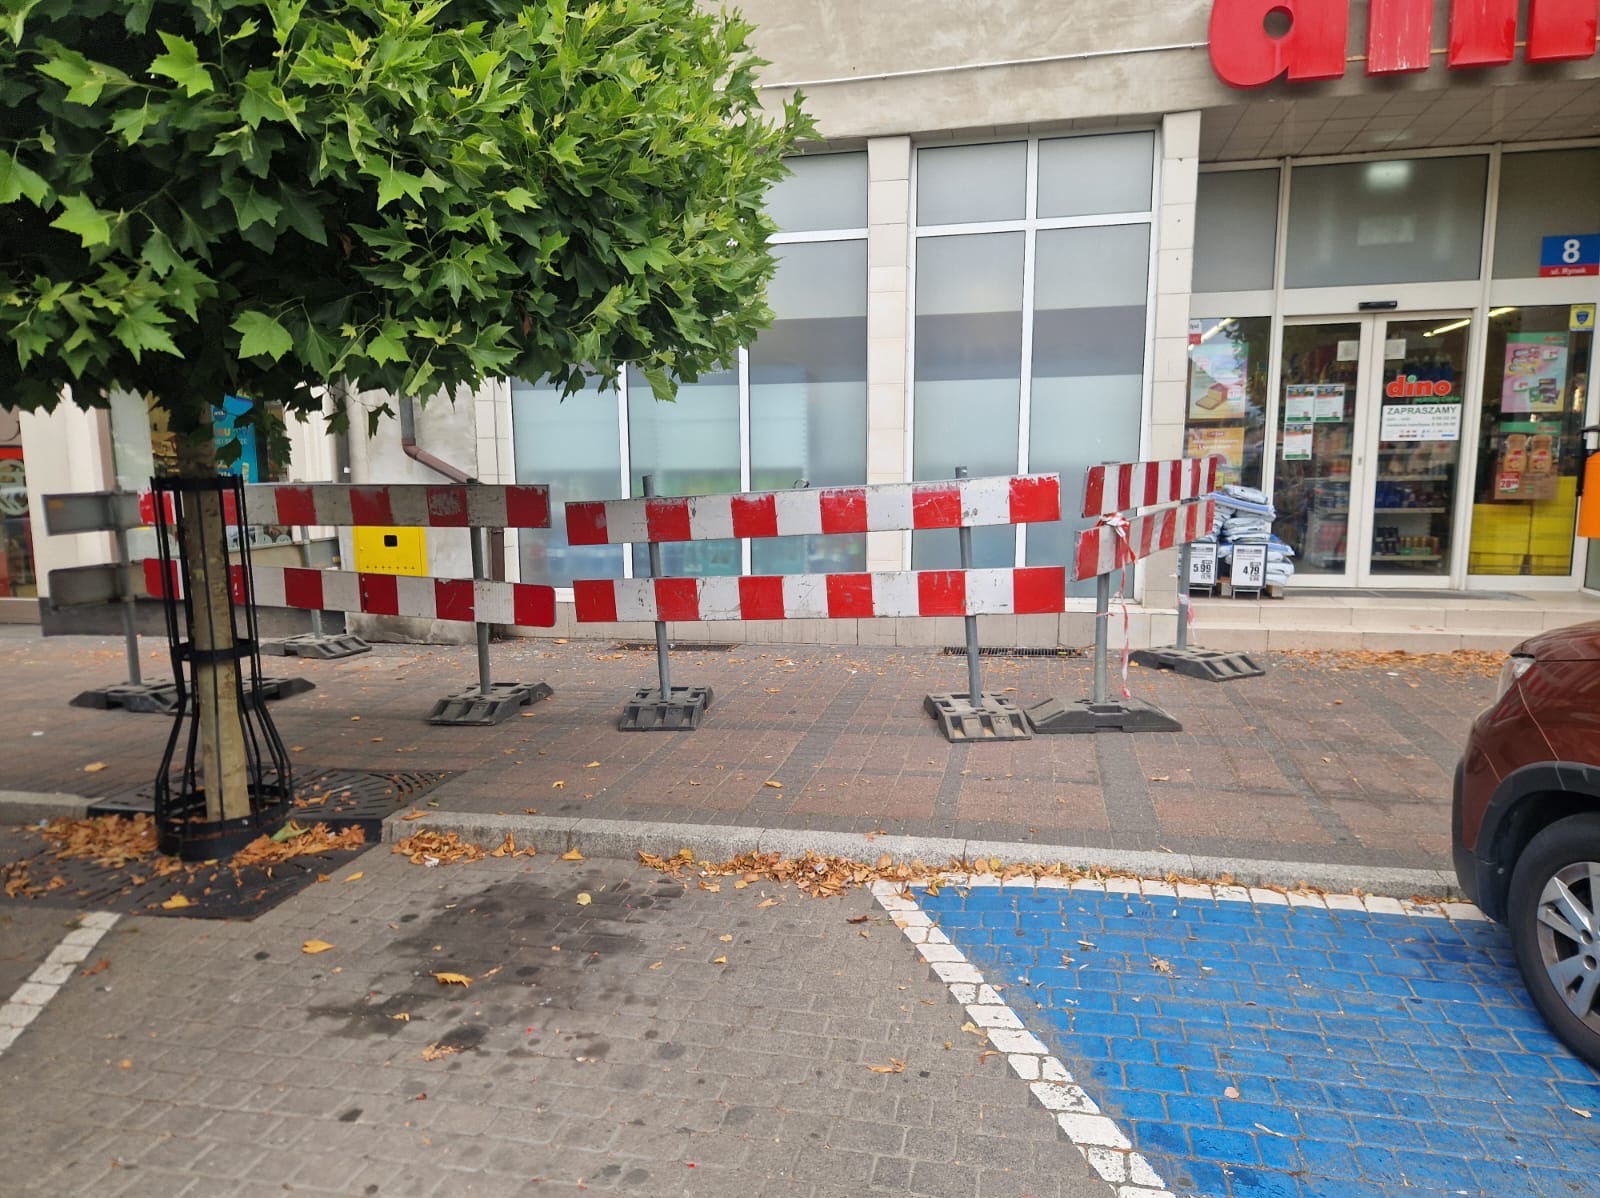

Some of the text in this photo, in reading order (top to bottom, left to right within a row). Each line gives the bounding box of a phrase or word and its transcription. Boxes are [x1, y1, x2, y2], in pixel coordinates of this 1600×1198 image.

[1562, 239, 1580, 263] 8
[1386, 374, 1452, 397] dino
[1387, 406, 1457, 415] ZAPRASZAMY
